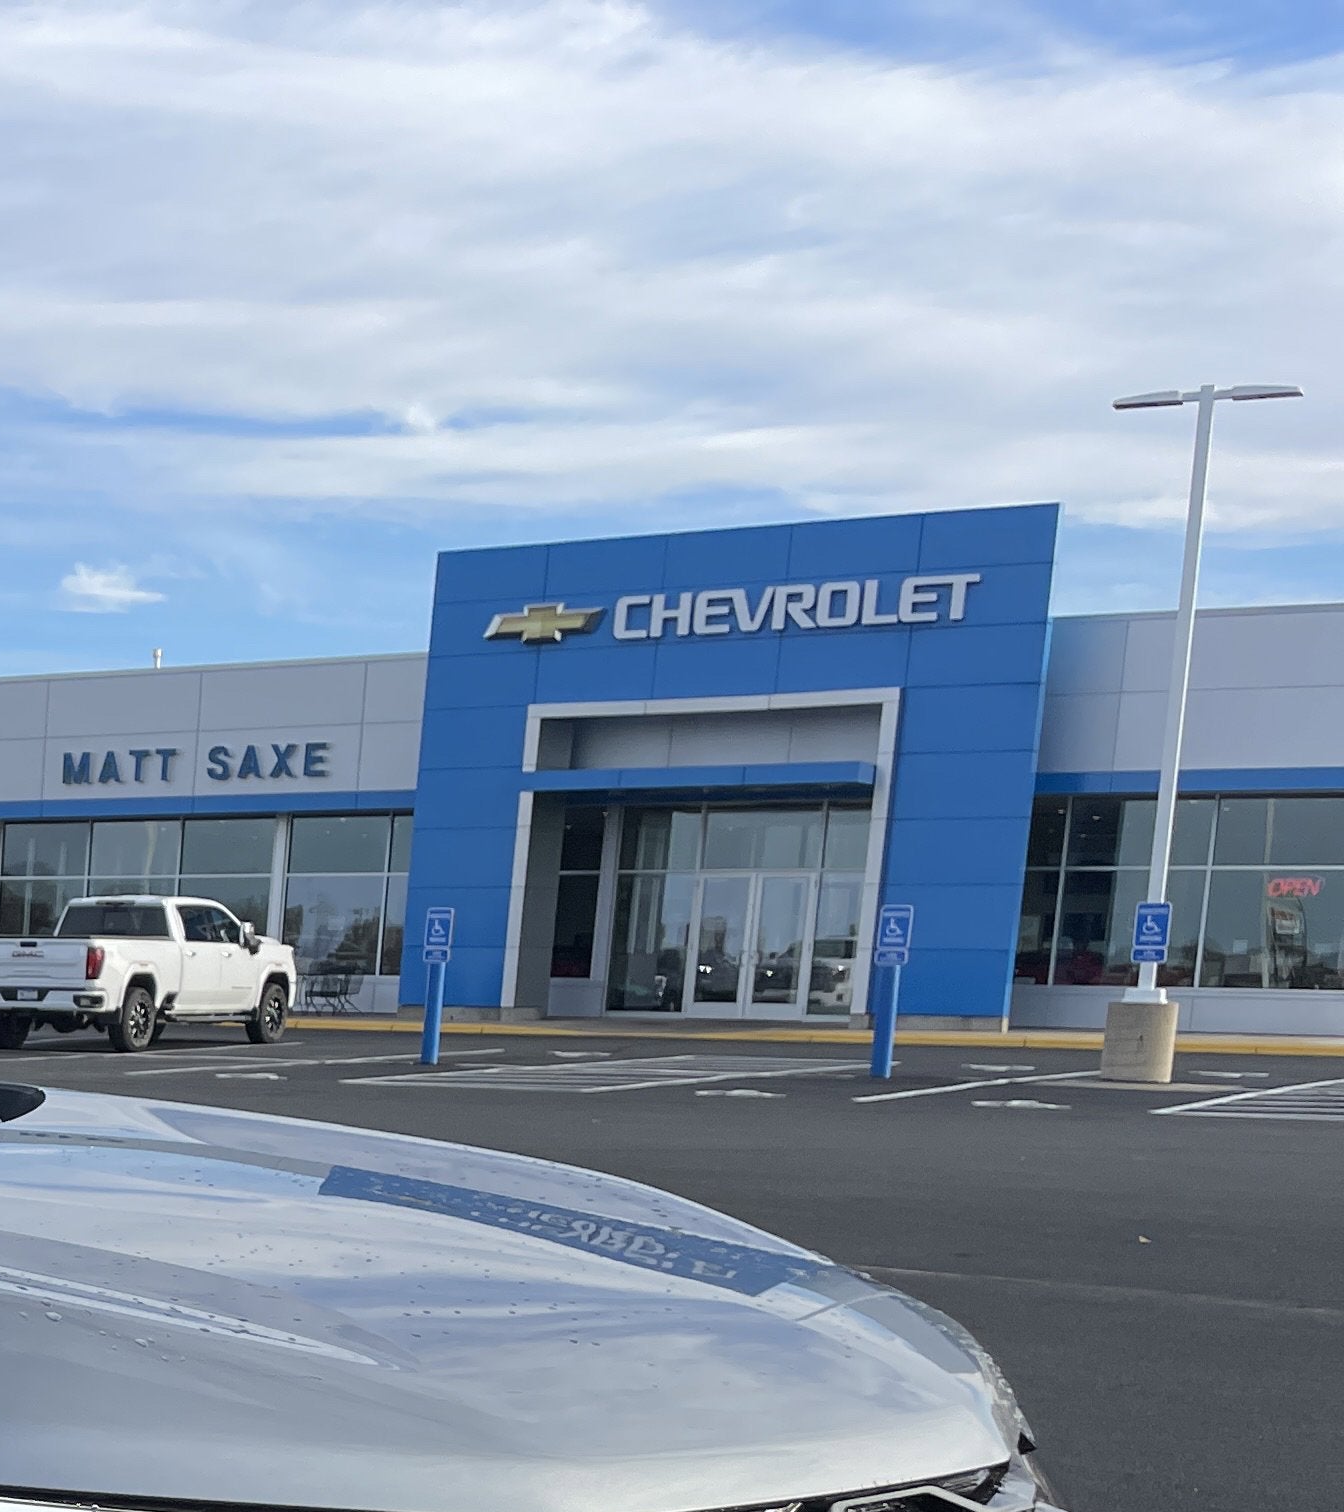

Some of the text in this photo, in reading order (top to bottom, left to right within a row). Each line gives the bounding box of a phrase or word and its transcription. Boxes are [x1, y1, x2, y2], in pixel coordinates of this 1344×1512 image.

[613, 573, 981, 640] CHEVROLET
[62, 742, 330, 785] MATT SAXE
[1268, 878, 1321, 897] OPEN
